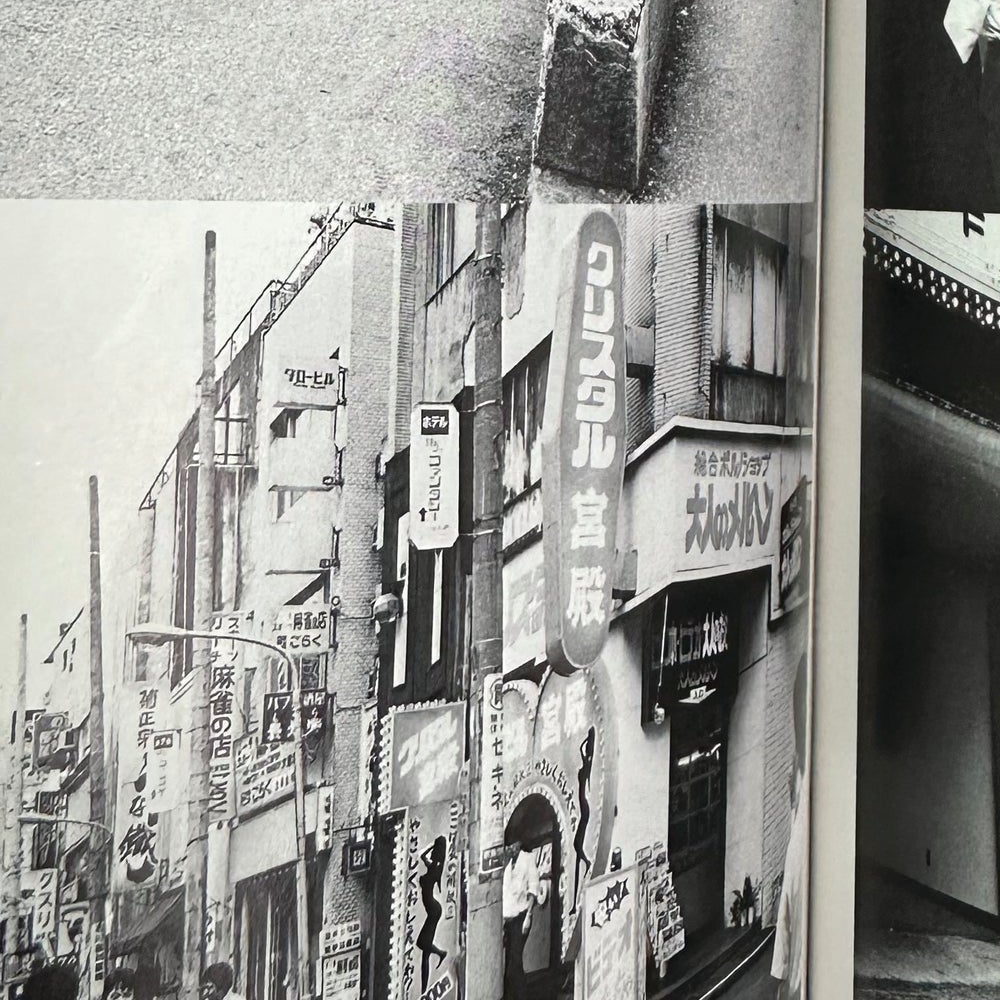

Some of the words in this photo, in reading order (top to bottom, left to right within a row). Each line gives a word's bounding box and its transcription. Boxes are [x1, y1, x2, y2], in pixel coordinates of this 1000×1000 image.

[572, 241, 616, 469] クリスタル
[422, 415, 448, 429] ホテル
[206, 664, 235, 760] 麻雀の店
